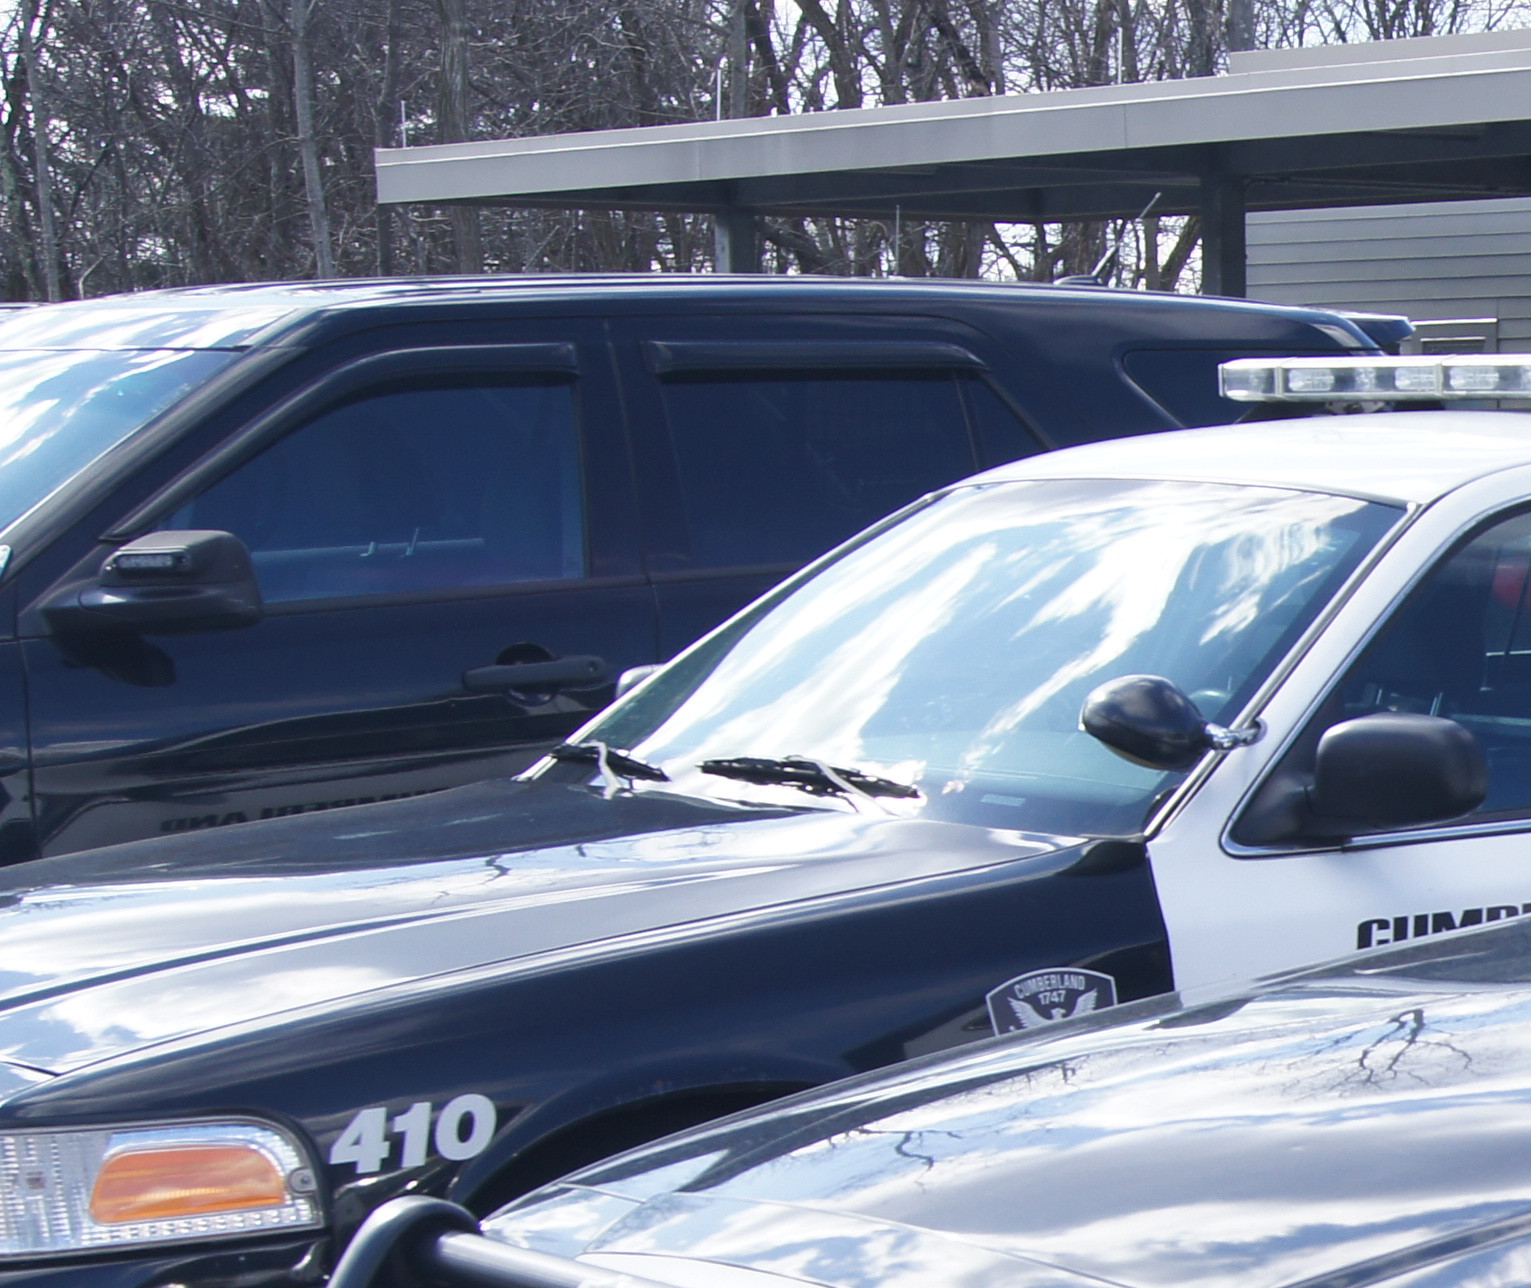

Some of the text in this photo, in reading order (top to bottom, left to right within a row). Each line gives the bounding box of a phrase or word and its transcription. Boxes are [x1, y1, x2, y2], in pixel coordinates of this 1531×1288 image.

[1014, 974, 1086, 999] CUMBERLAND
[1038, 990, 1066, 1005] 1747
[329, 1093, 497, 1174] 410
